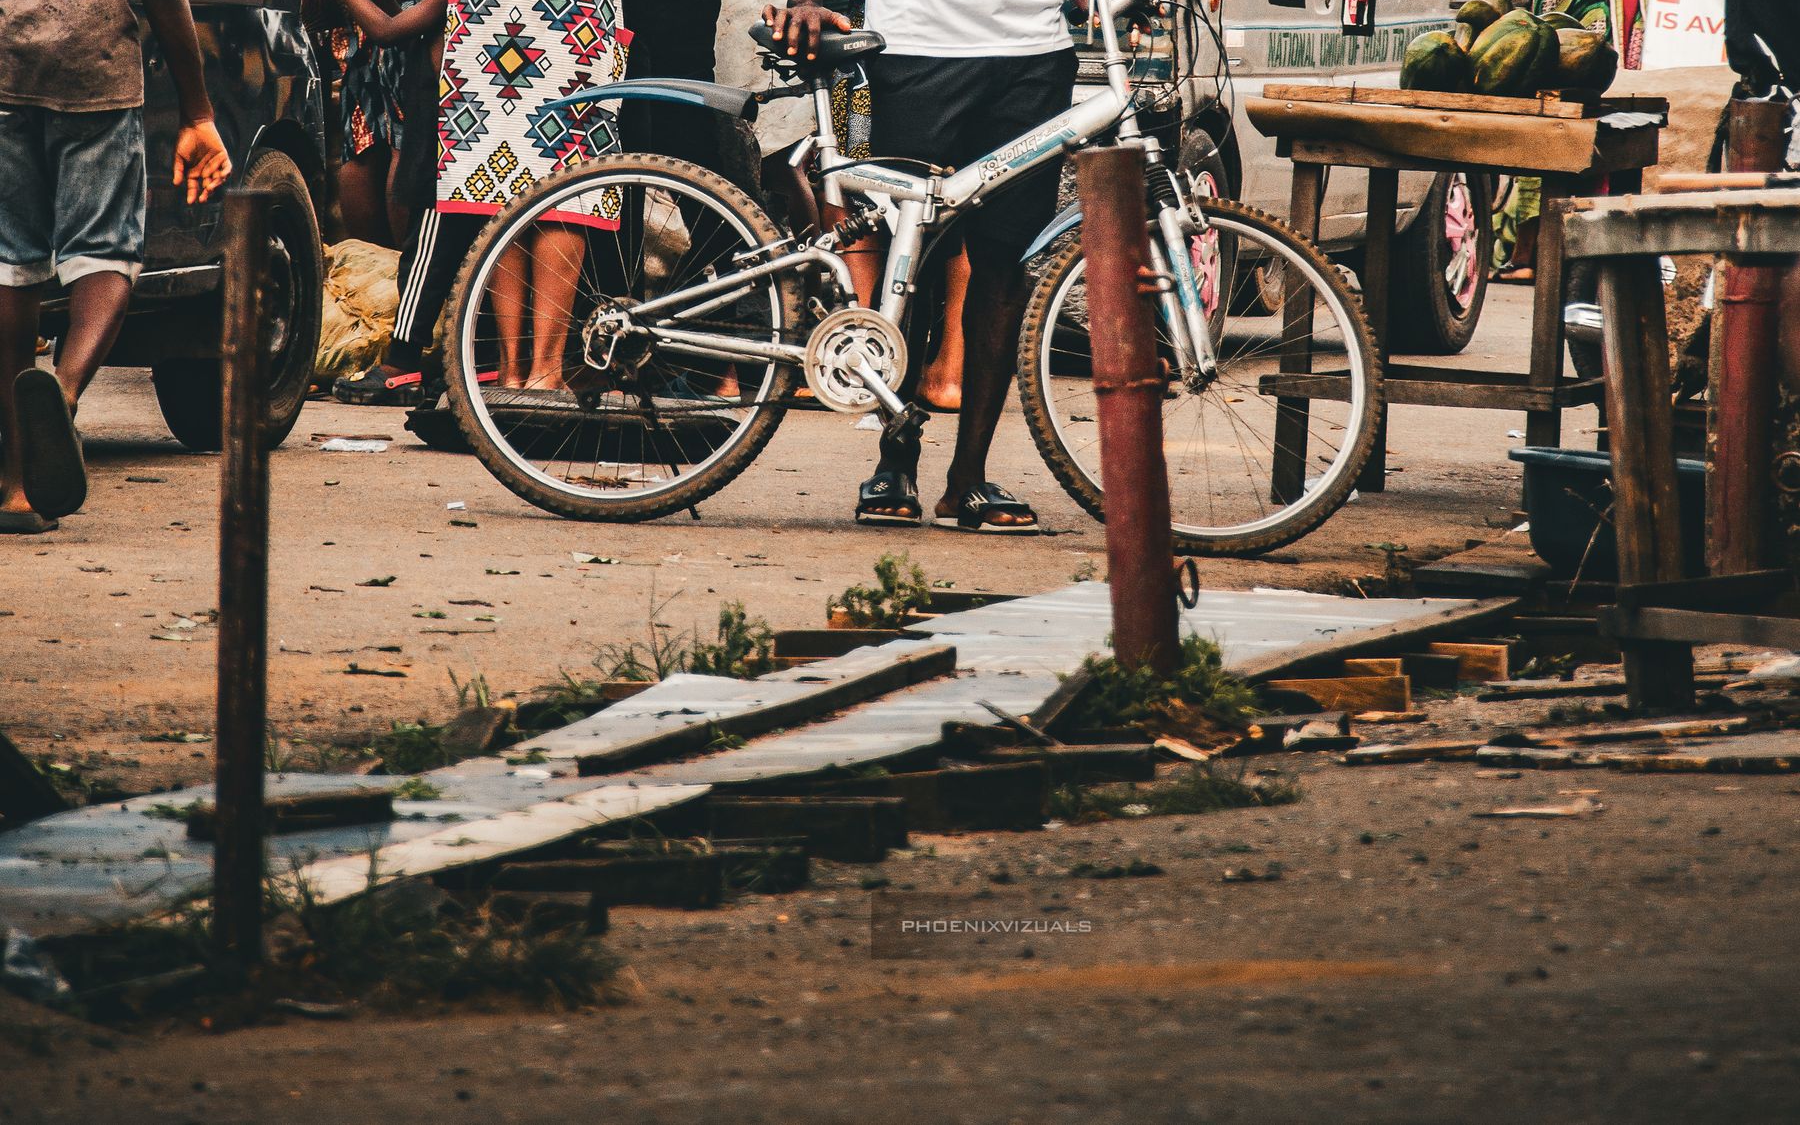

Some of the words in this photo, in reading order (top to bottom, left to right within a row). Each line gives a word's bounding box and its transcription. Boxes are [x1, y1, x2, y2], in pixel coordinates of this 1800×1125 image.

[1655, 10, 1678, 30] IS
[1268, 32, 1316, 69] NATIONAL
[978, 134, 1038, 181] FOLDING
